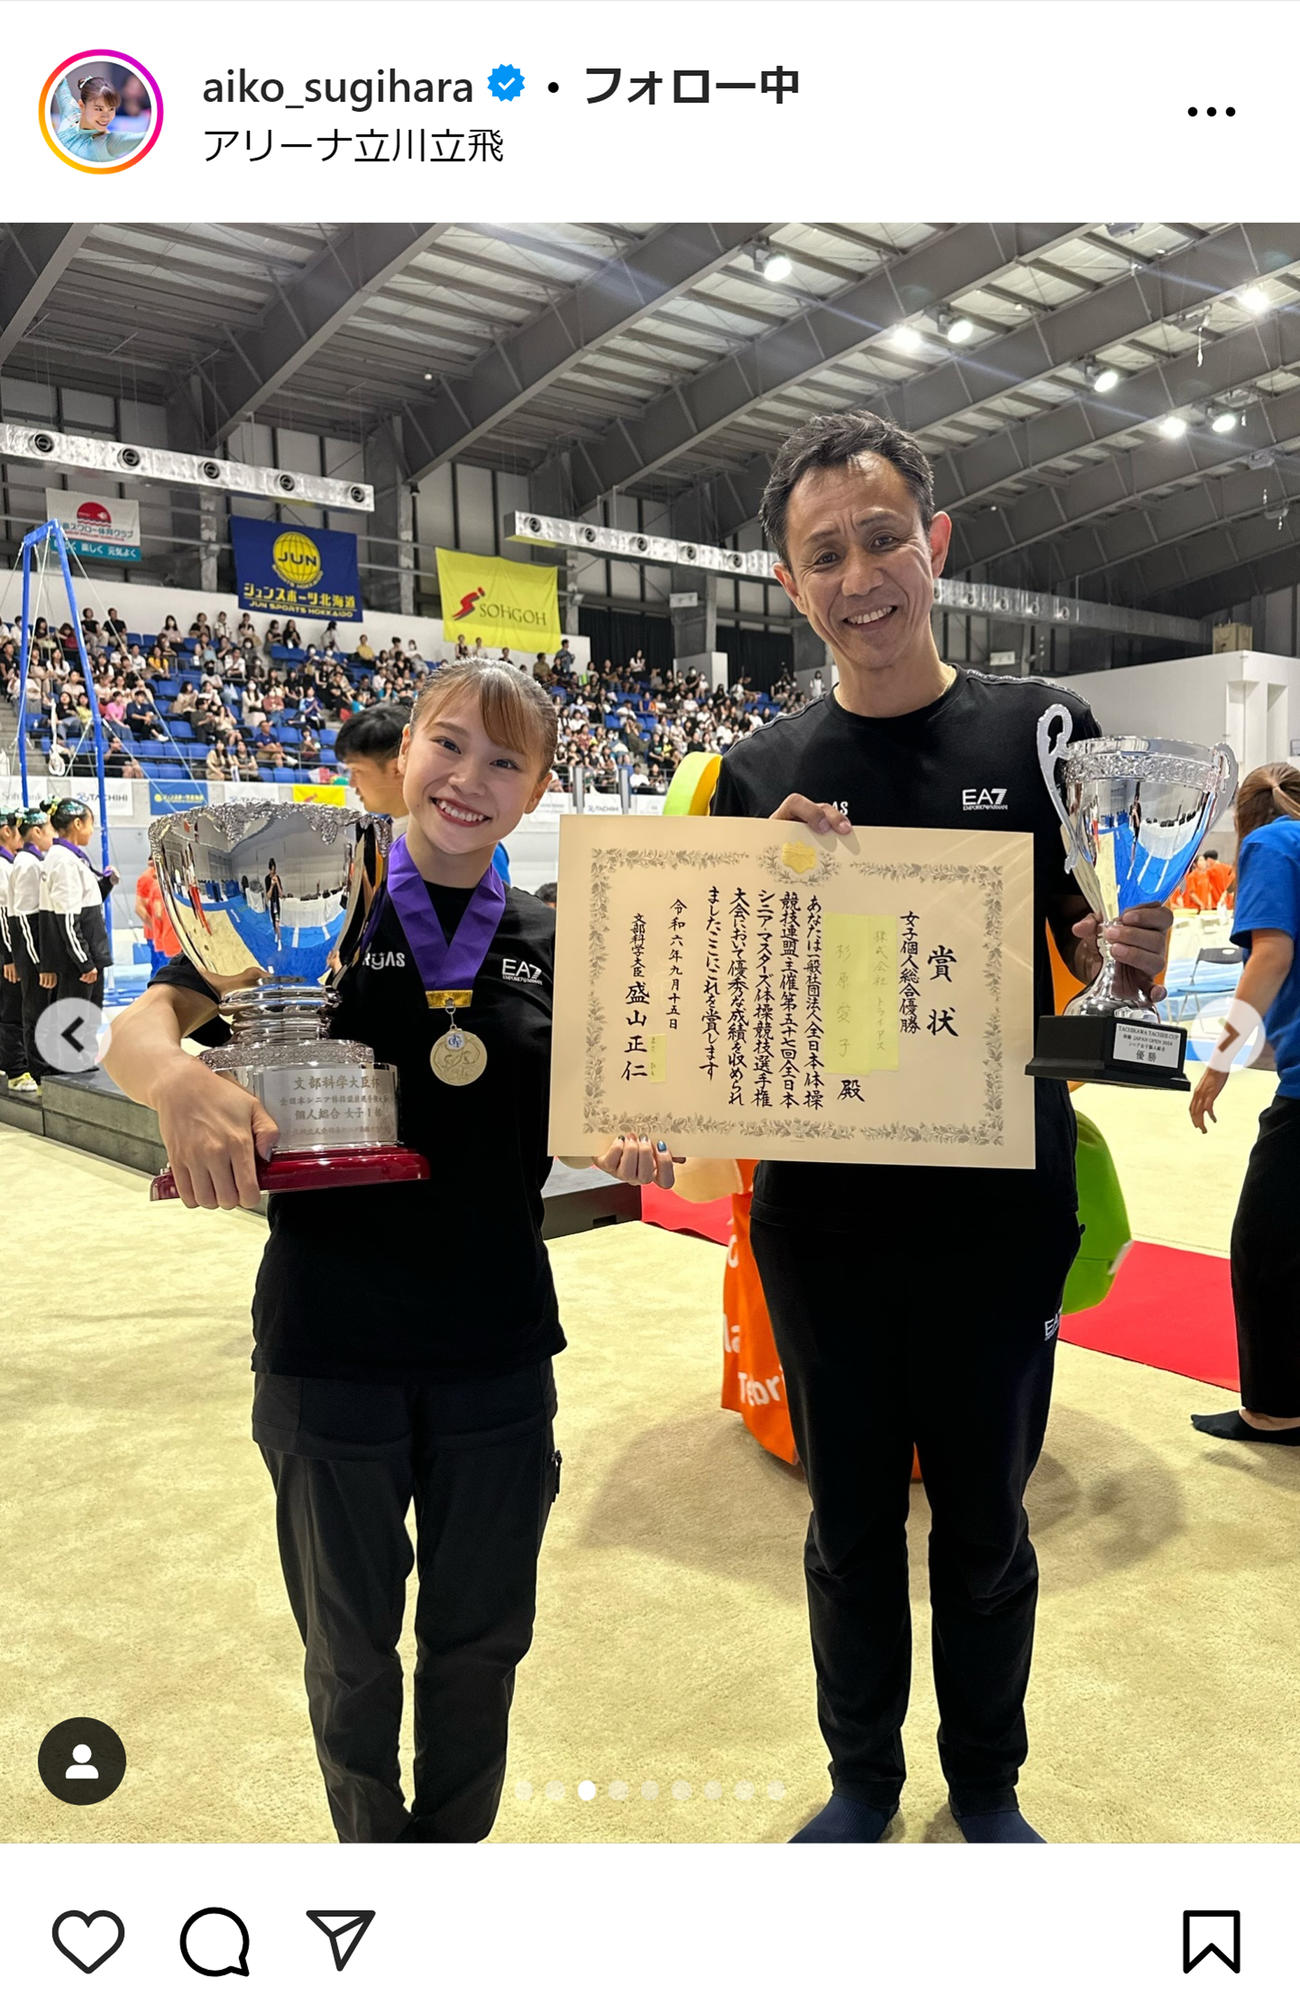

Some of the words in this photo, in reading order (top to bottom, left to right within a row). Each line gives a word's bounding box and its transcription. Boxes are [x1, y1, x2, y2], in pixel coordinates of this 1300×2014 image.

[243, 582, 357, 609] ジュンスポーツ北海道
[278, 551, 317, 567] JUN
[269, 602, 307, 614] SPORTS
[479, 603, 547, 626] SOHGOH
[962, 788, 1008, 805] EA7
[502, 958, 542, 979] EA7
[629, 913, 647, 978] 文部科学大臣
[666, 898, 687, 1030] 令和六年九月十五日
[699, 886, 722, 1081] ましたここにこれを賞します
[899, 910, 921, 1034] 女子個人総合優勝
[727, 887, 751, 1106] 大会において優秀な成績を収められ
[779, 891, 801, 1109] 競技連盟主催第五十七回全日本
[803, 894, 824, 1111] あなたは一般社団法人全日本体操
[927, 944, 959, 1037] 賞状
[621, 981, 650, 1081] 盛山正仁
[837, 1079, 865, 1102] 殿
